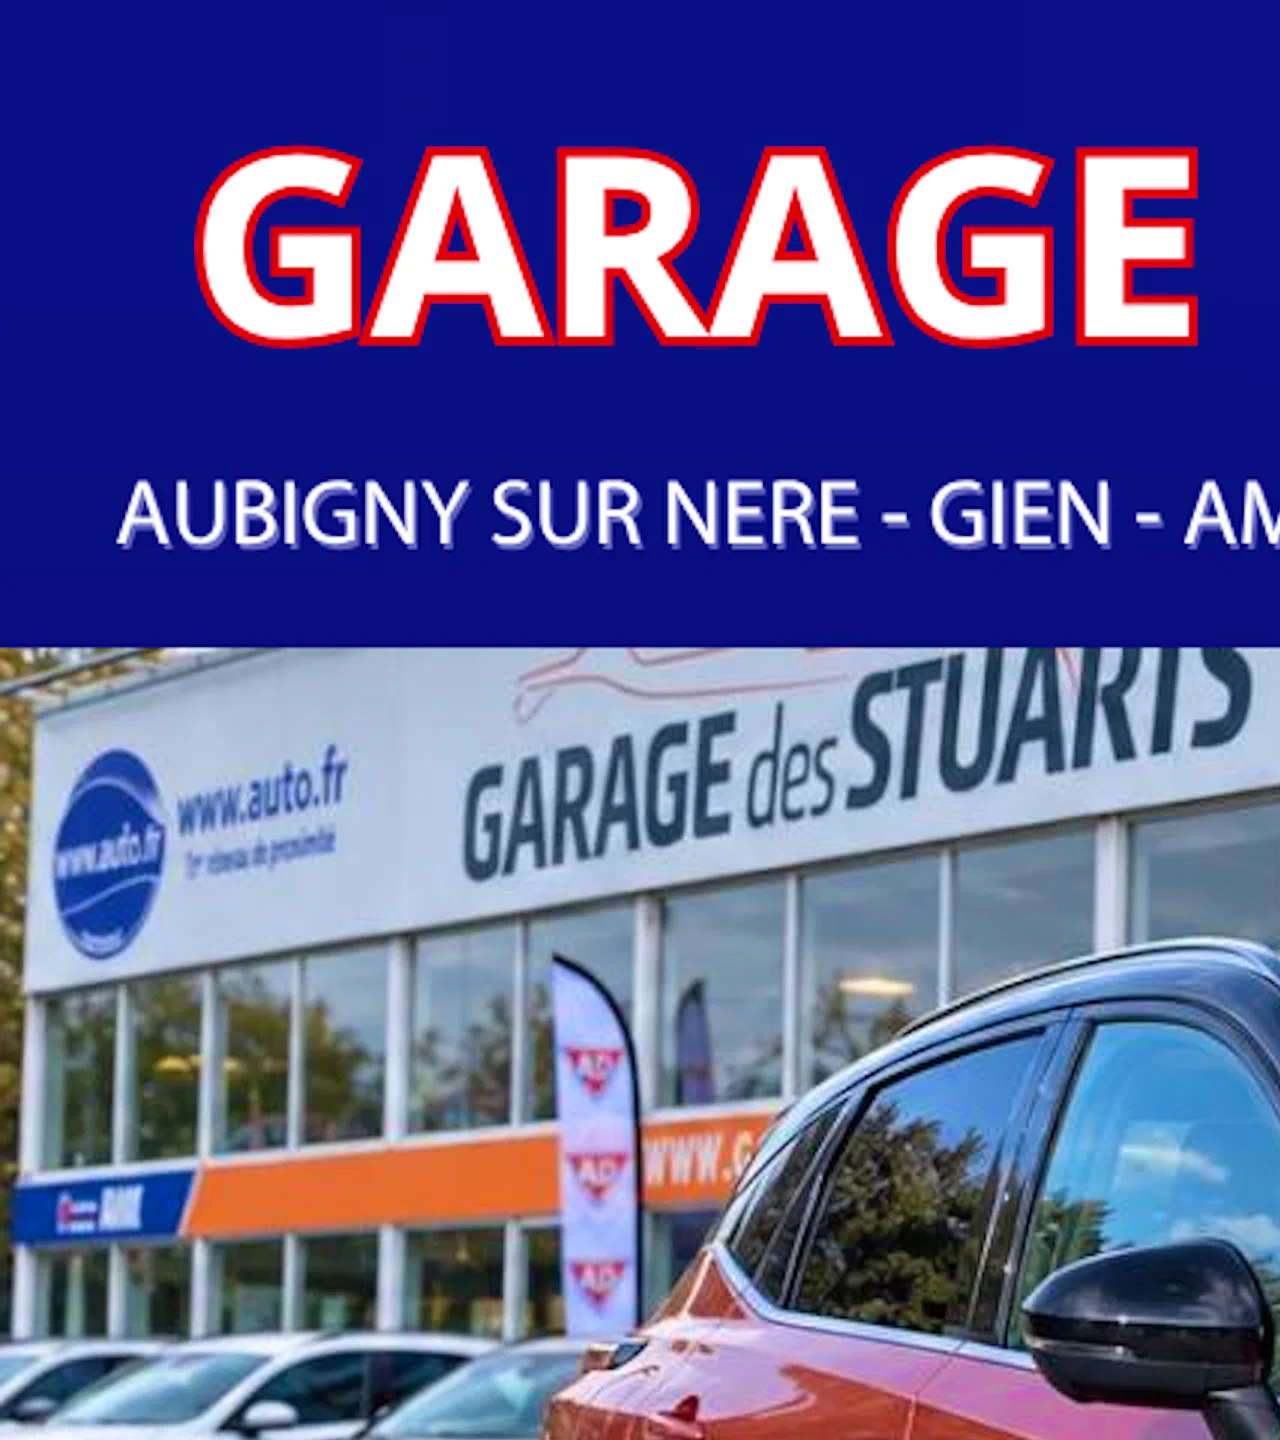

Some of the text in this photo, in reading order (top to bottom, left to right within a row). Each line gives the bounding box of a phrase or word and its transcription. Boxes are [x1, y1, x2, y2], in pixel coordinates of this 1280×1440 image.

[177, 745, 348, 836] www.auto.fr
[463, 647, 1252, 882] GARAGE des STUARTS
